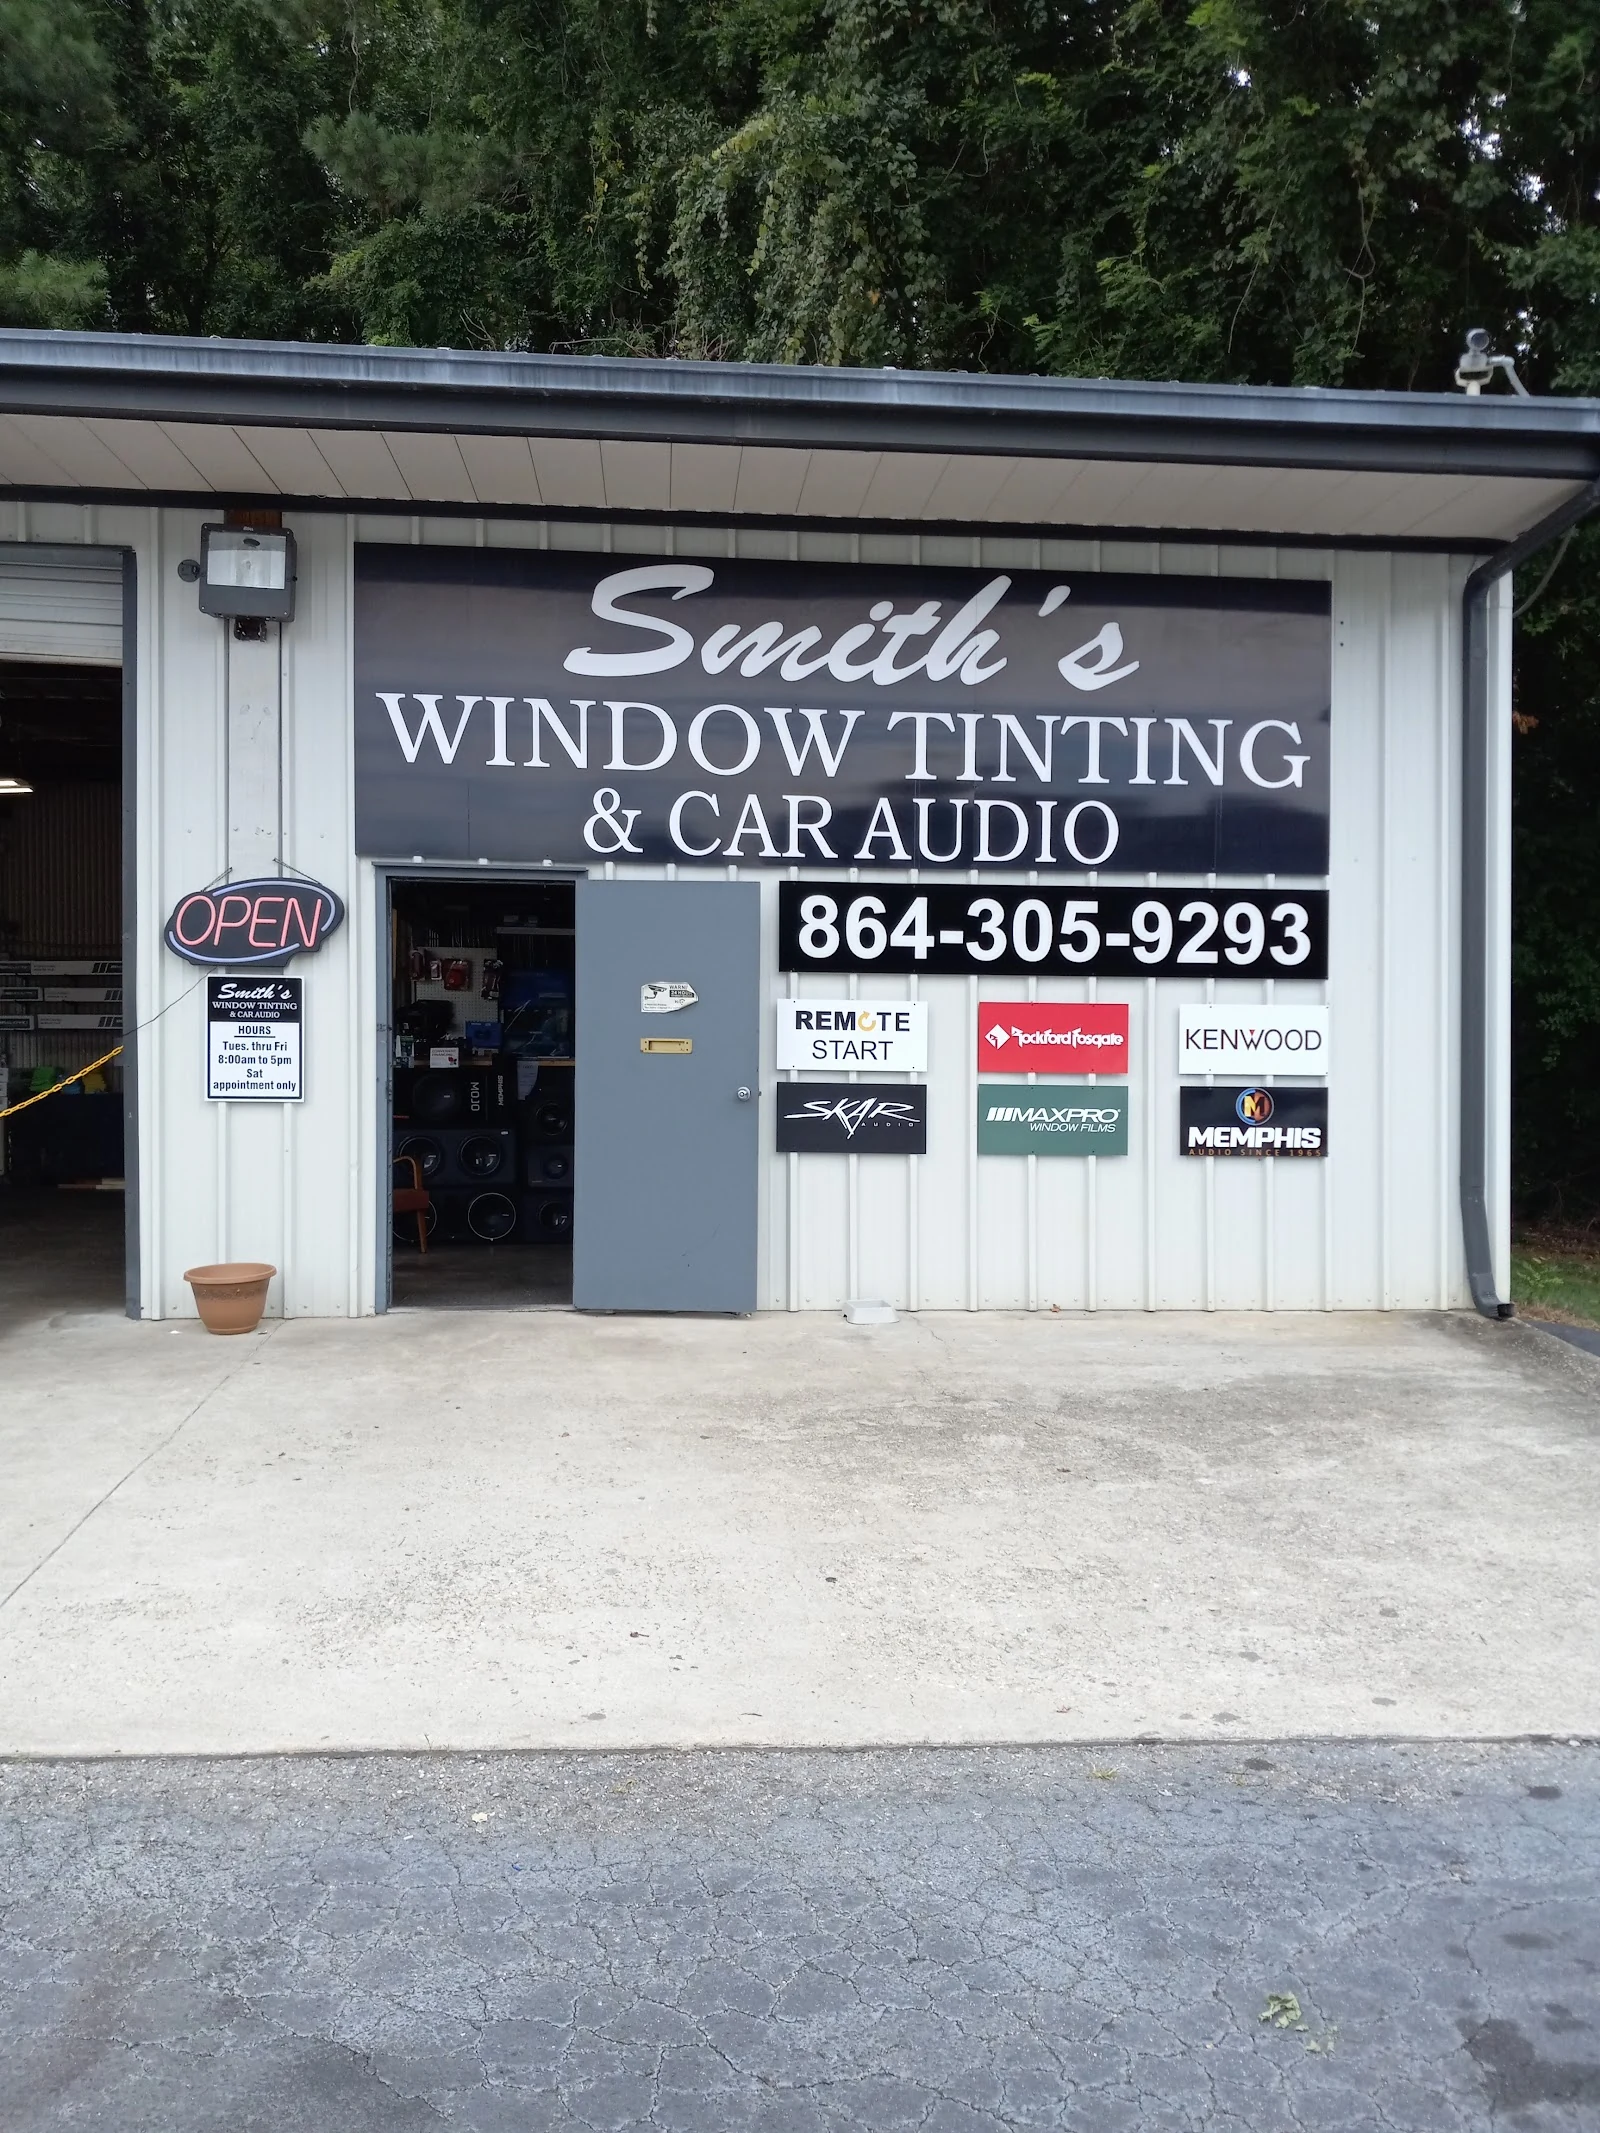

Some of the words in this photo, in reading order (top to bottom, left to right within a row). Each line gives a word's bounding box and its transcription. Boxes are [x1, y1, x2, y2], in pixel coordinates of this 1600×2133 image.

[562, 564, 1140, 692] Smith's
[375, 692, 866, 778] WINDOW
[886, 711, 1311, 789] TINTING
[583, 787, 644, 853] &
[669, 790, 839, 859] CAR
[853, 797, 1119, 865] AUDIO
[176, 895, 322, 947] OPEN
[798, 894, 1311, 966] 864-305-9293
[217, 983, 292, 1000] Smith's
[212, 1001, 256, 1010] WINDOW
[257, 1001, 298, 1011] TINTING
[229, 1010, 236, 1018] &
[237, 1010, 253, 1018] CAR
[254, 1011, 280, 1019] AUDIO
[238, 1025, 271, 1035] HOURS
[795, 1010, 910, 1032] REMOTE
[222, 1040, 249, 1051] Tues.
[251, 1041, 272, 1051] thru
[274, 1041, 288, 1051] Fri
[1011, 1025, 1071, 1048] Rockford
[1072, 1027, 1124, 1049] Fosgate
[1185, 1028, 1322, 1051] KENWOOD
[218, 1054, 256, 1065] 8:00am
[258, 1055, 268, 1065] to
[270, 1055, 292, 1067] 5pm
[812, 1039, 894, 1061] START
[246, 1068, 263, 1079] Sat
[213, 1080, 274, 1092] appointment
[276, 1081, 297, 1092] only
[470, 1082, 480, 1111] MOJO
[783, 1097, 921, 1140] SKAR
[1030, 1122, 1079, 1132] WINDOW
[1080, 1122, 1117, 1133] FILMS
[1188, 1126, 1322, 1149] MEMPHIS
[1240, 1149, 1280, 1157] SINCE
[1290, 1149, 1322, 1157] 1965
